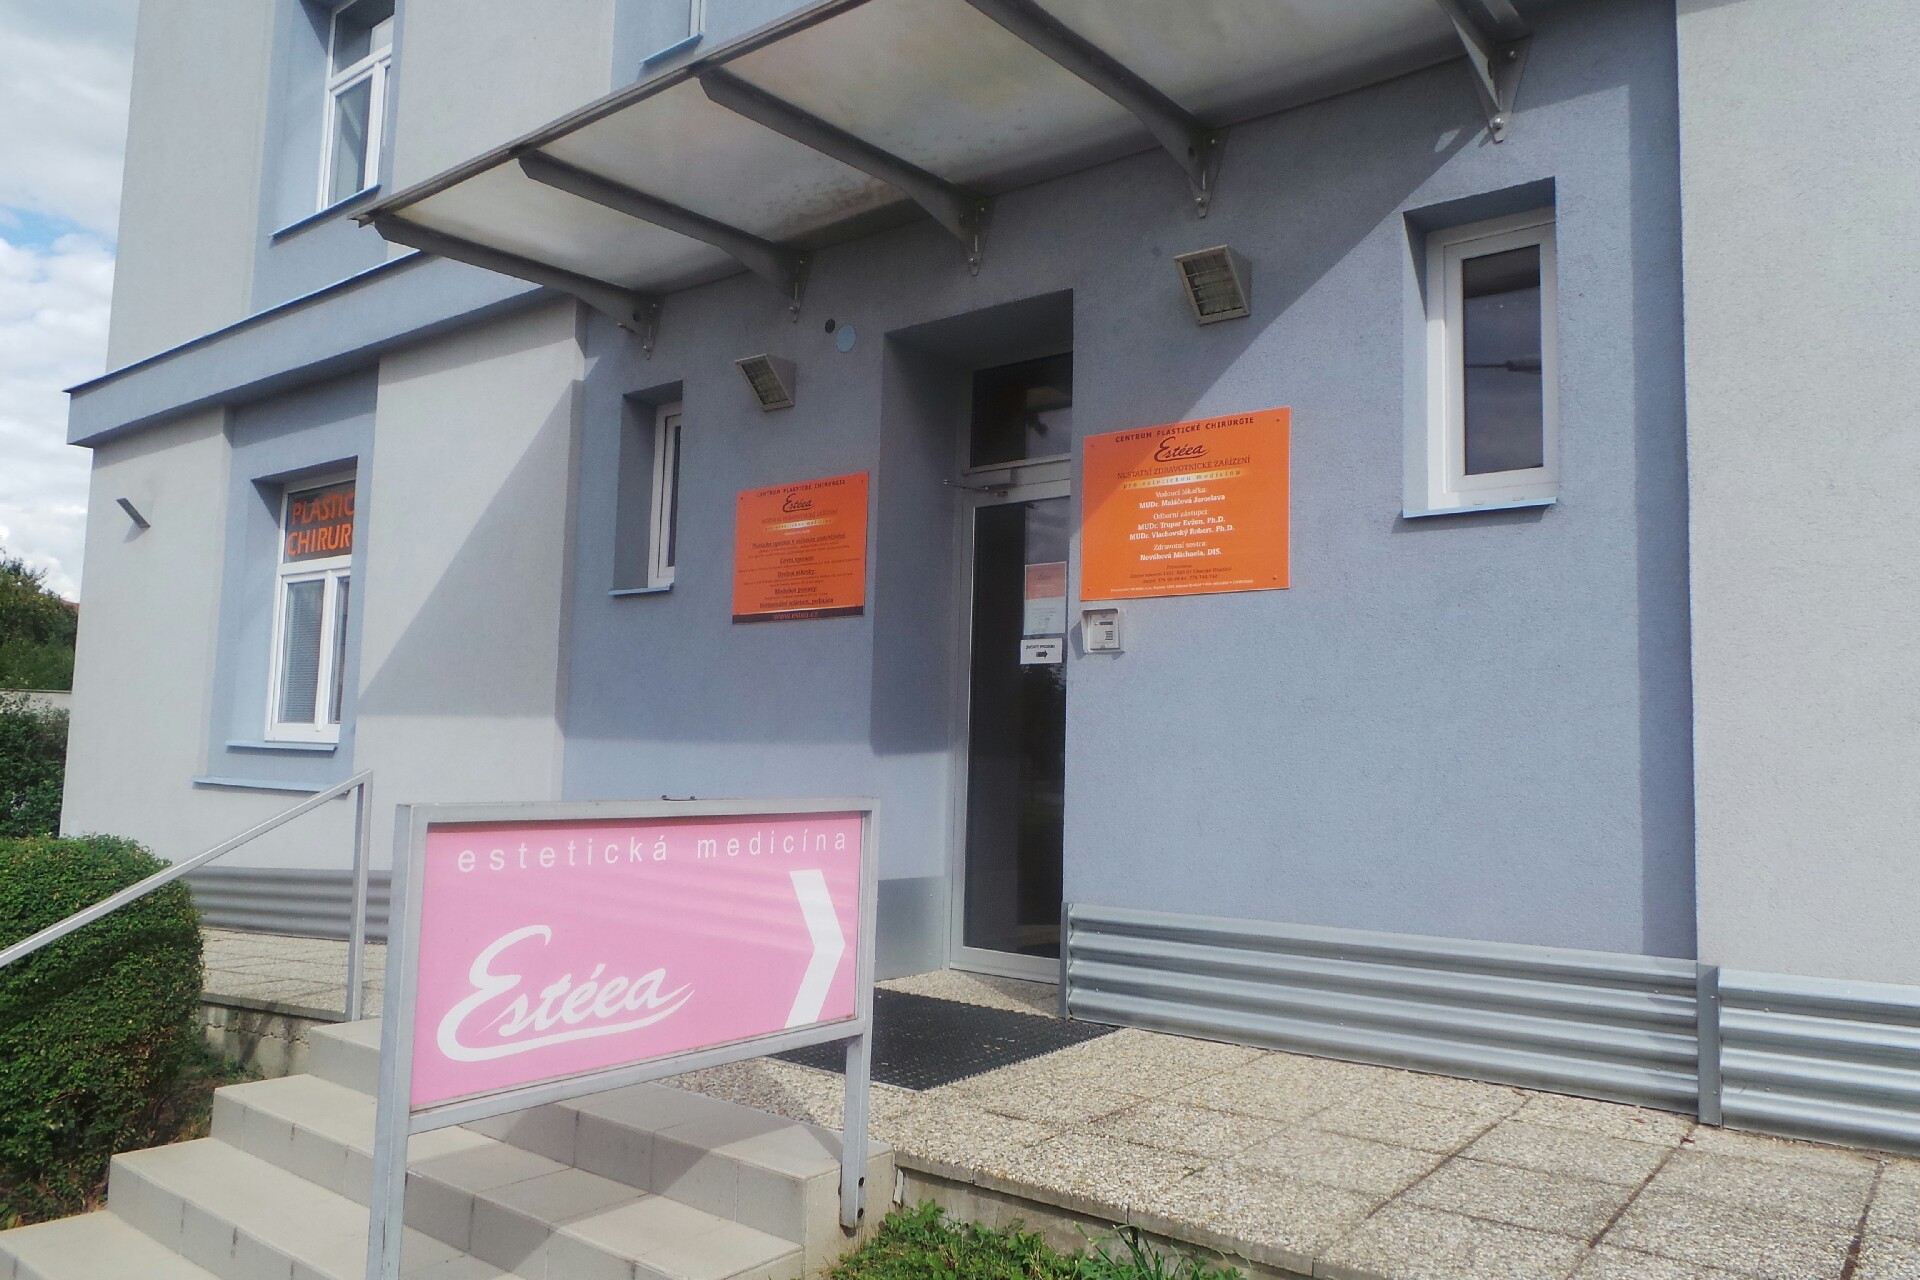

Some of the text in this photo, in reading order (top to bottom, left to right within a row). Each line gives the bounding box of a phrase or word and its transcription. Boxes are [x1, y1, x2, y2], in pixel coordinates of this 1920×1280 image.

[1115, 417, 1254, 443] CENTRUM PLASTICKÉ CHIRURGIE
[1213, 455, 1250, 468] ZAŘÍZENÍ
[1139, 501, 1160, 509] MUDr.
[1193, 494, 1226, 504] Jaroslava
[1137, 522, 1158, 531] MUDr.
[1207, 516, 1226, 524] Ph.D.
[1216, 524, 1235, 533] Ph.D.
[457, 829, 846, 874] estetická medicína
[437, 925, 696, 1062] Estéea
